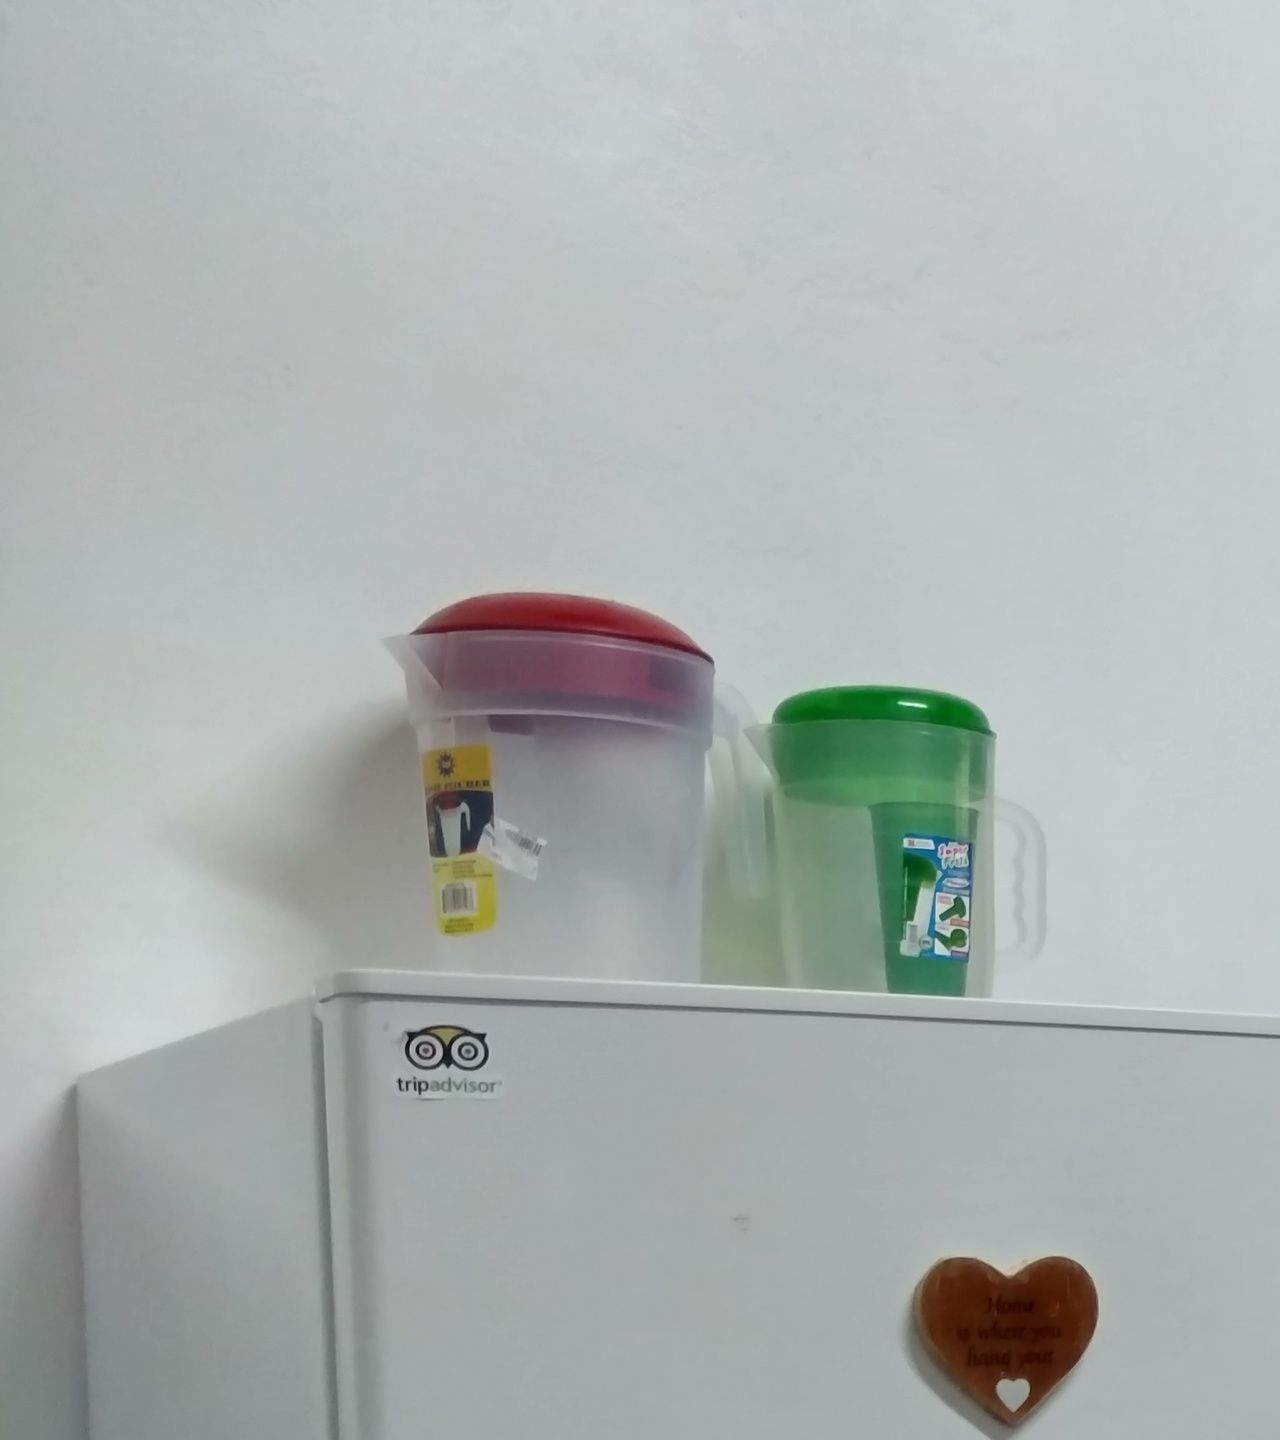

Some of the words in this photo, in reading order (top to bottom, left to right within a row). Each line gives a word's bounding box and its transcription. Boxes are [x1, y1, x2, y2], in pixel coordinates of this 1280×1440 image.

[396, 1076, 497, 1095] tripadvisor
[984, 1293, 1036, 1314] Home
[1031, 1325, 1063, 1343] you
